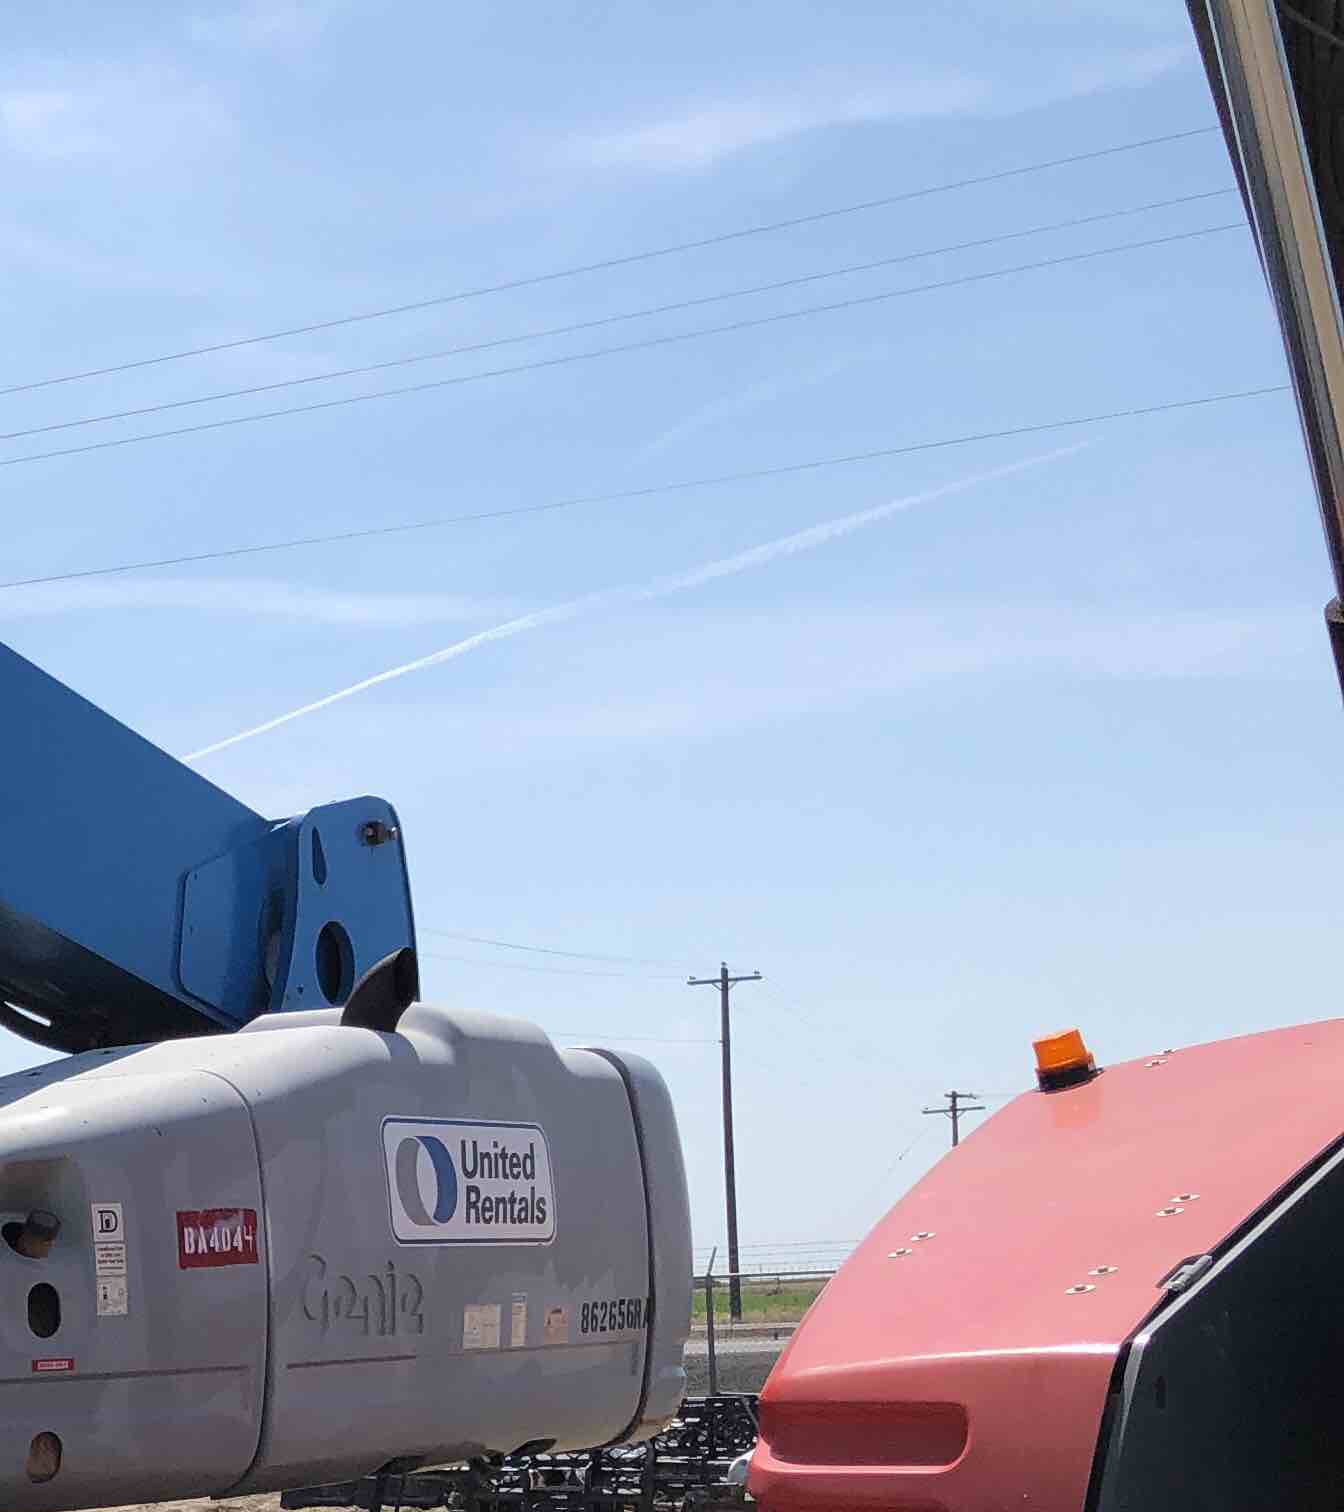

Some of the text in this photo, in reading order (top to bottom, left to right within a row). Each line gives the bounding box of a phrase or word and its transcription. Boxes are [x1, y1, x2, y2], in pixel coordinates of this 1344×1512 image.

[461, 1139, 536, 1180] United
[465, 1184, 547, 1225] Rentals
[302, 1253, 424, 1337] Genie
